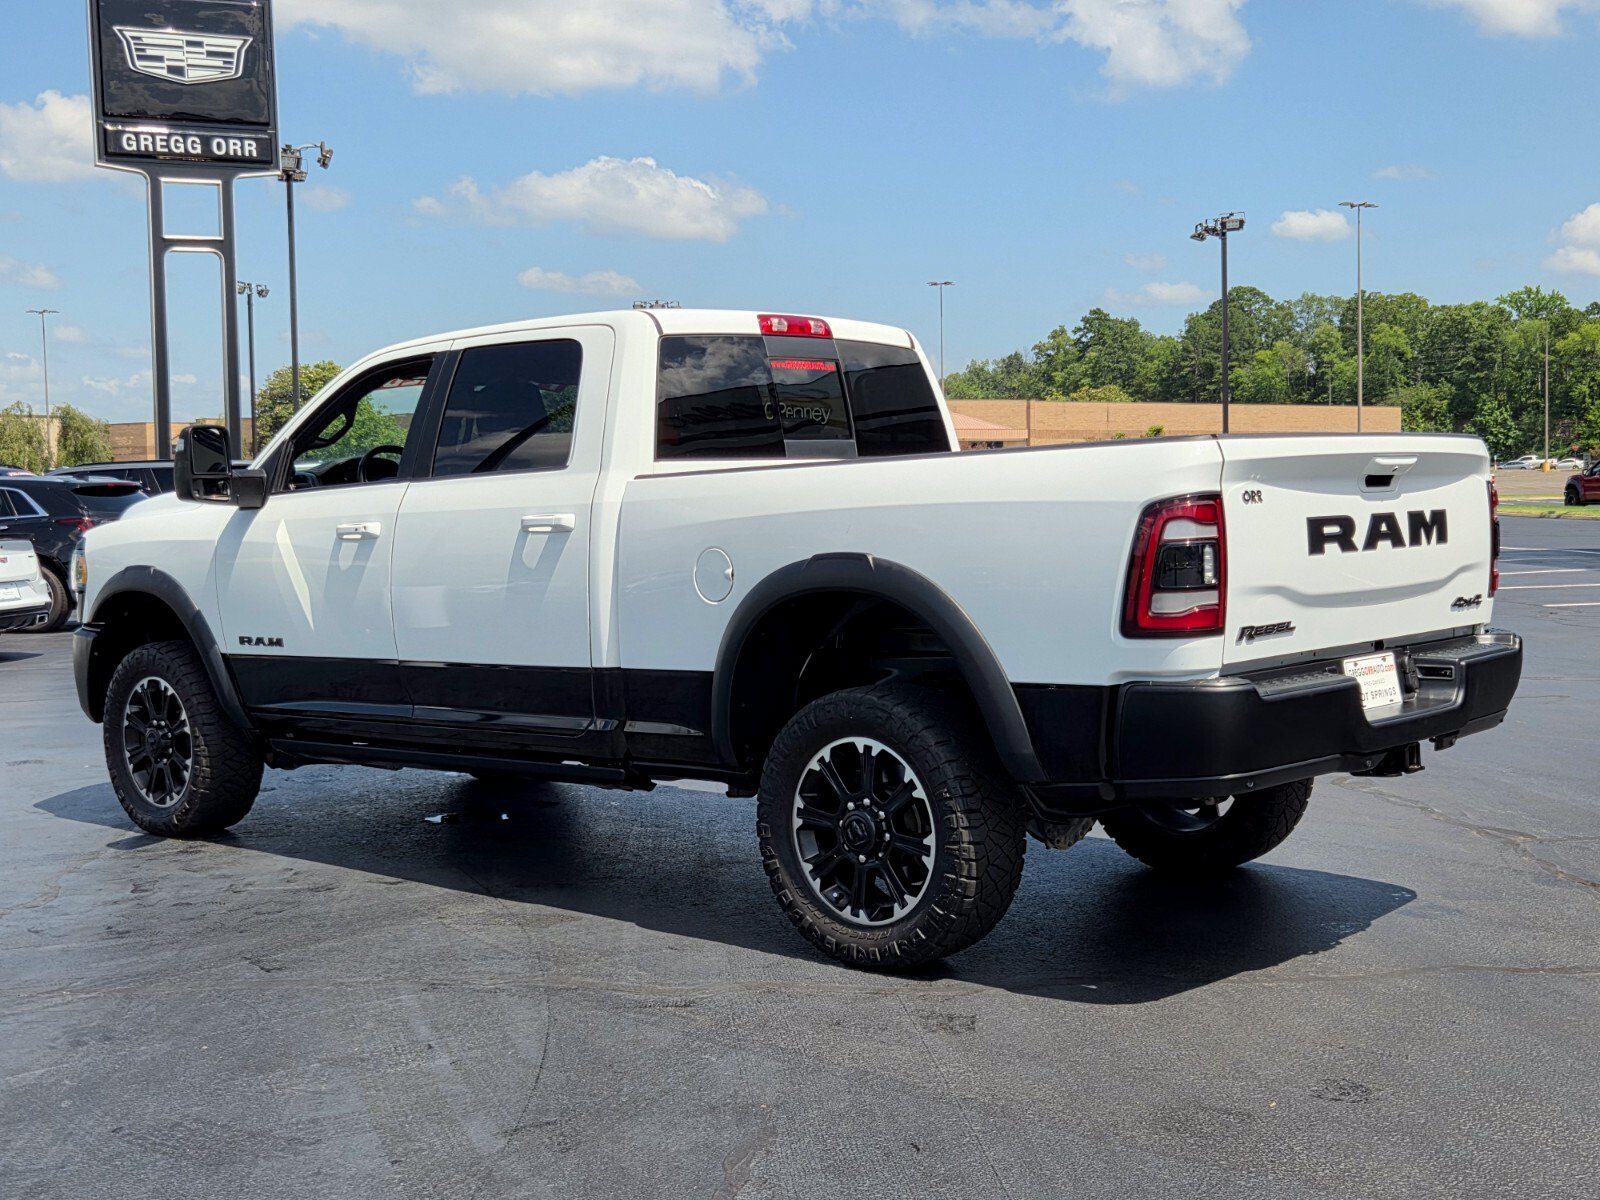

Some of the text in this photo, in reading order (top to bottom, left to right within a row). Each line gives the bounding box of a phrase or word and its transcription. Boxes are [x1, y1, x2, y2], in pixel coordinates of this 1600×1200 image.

[121, 133, 257, 157] GREGG ORR
[1242, 490, 1263, 504] ORR
[1306, 509, 1448, 556] RAM
[239, 636, 284, 648] RAM
[1370, 687, 1397, 699] SPRINGS
